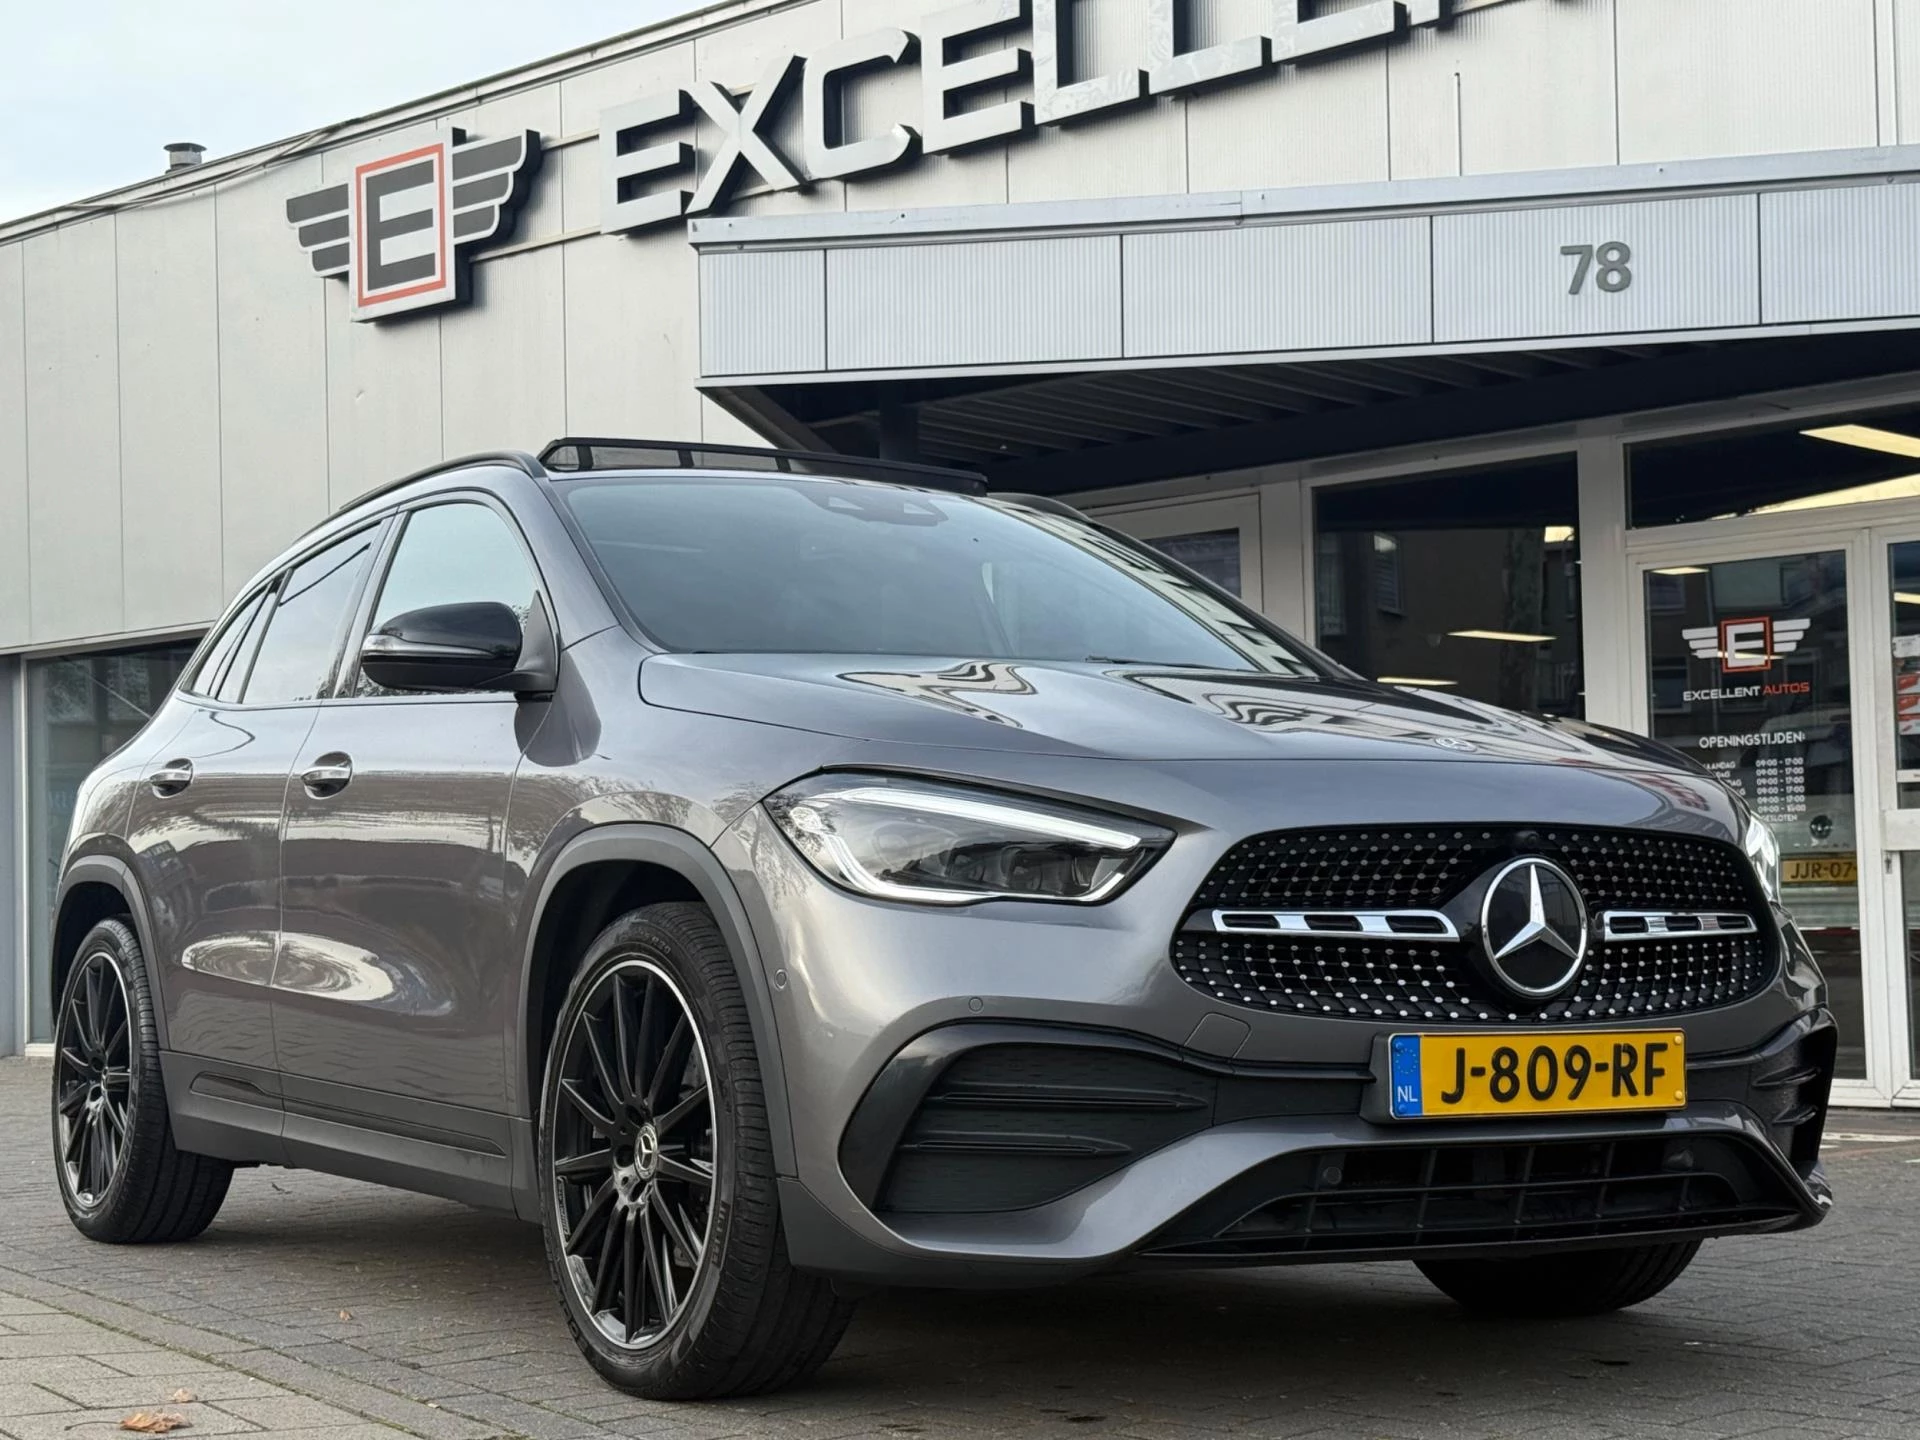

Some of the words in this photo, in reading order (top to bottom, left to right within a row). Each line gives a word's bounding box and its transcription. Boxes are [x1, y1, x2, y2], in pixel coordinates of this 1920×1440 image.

[1560, 241, 1632, 295] 78
[1683, 686, 1761, 701] EXCELLENT
[1763, 682, 1810, 695] AUTOS
[1699, 731, 1806, 749] OPENINGSTIJDEN:
[1397, 1086, 1418, 1103] NL
[1440, 1042, 1669, 1104] J-809-RF
